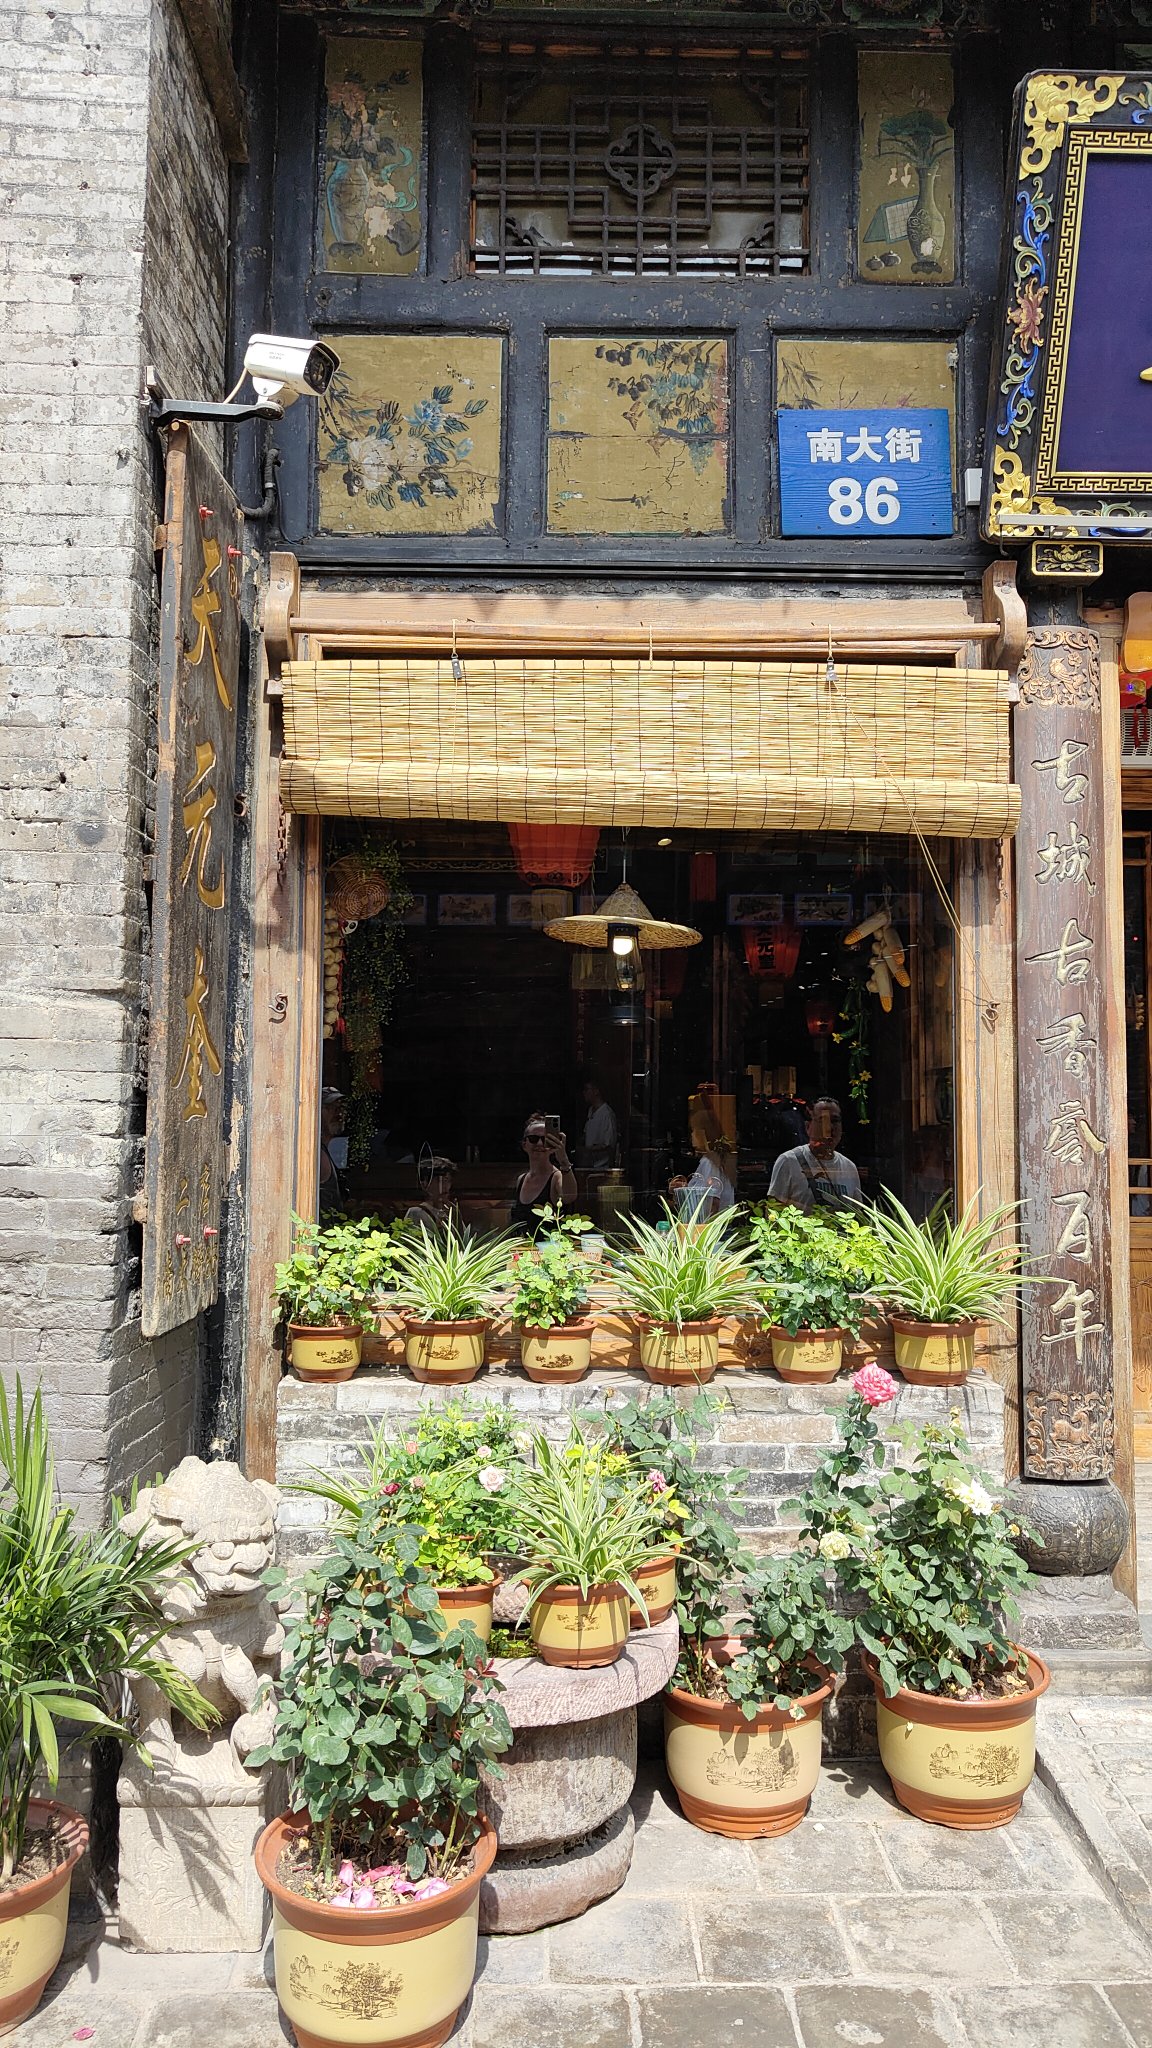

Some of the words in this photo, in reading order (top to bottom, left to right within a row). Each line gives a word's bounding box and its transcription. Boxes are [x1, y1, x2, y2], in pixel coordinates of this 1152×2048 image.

[806, 426, 923, 464] 南大街
[828, 476, 901, 525] 86
[171, 537, 233, 1122] 天元奎
